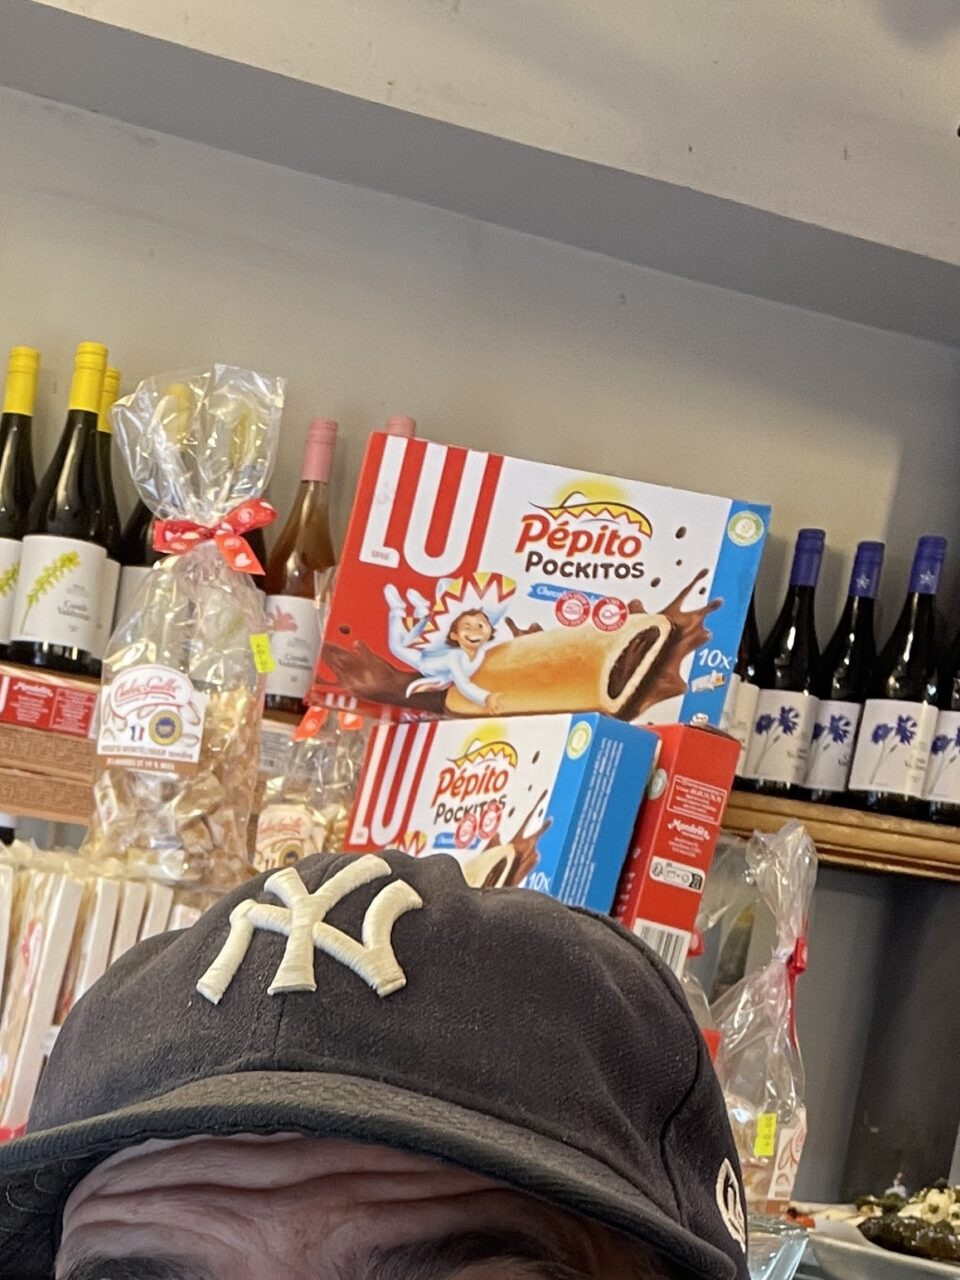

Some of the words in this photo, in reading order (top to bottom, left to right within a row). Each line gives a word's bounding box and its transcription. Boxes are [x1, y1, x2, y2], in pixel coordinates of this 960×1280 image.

[359, 435, 490, 578] LU
[514, 513, 643, 559] Pépito
[524, 550, 646, 581] POCKITOS
[349, 722, 431, 847] LU
[430, 766, 510, 808] Pépito
[195, 854, 424, 1003] NY
